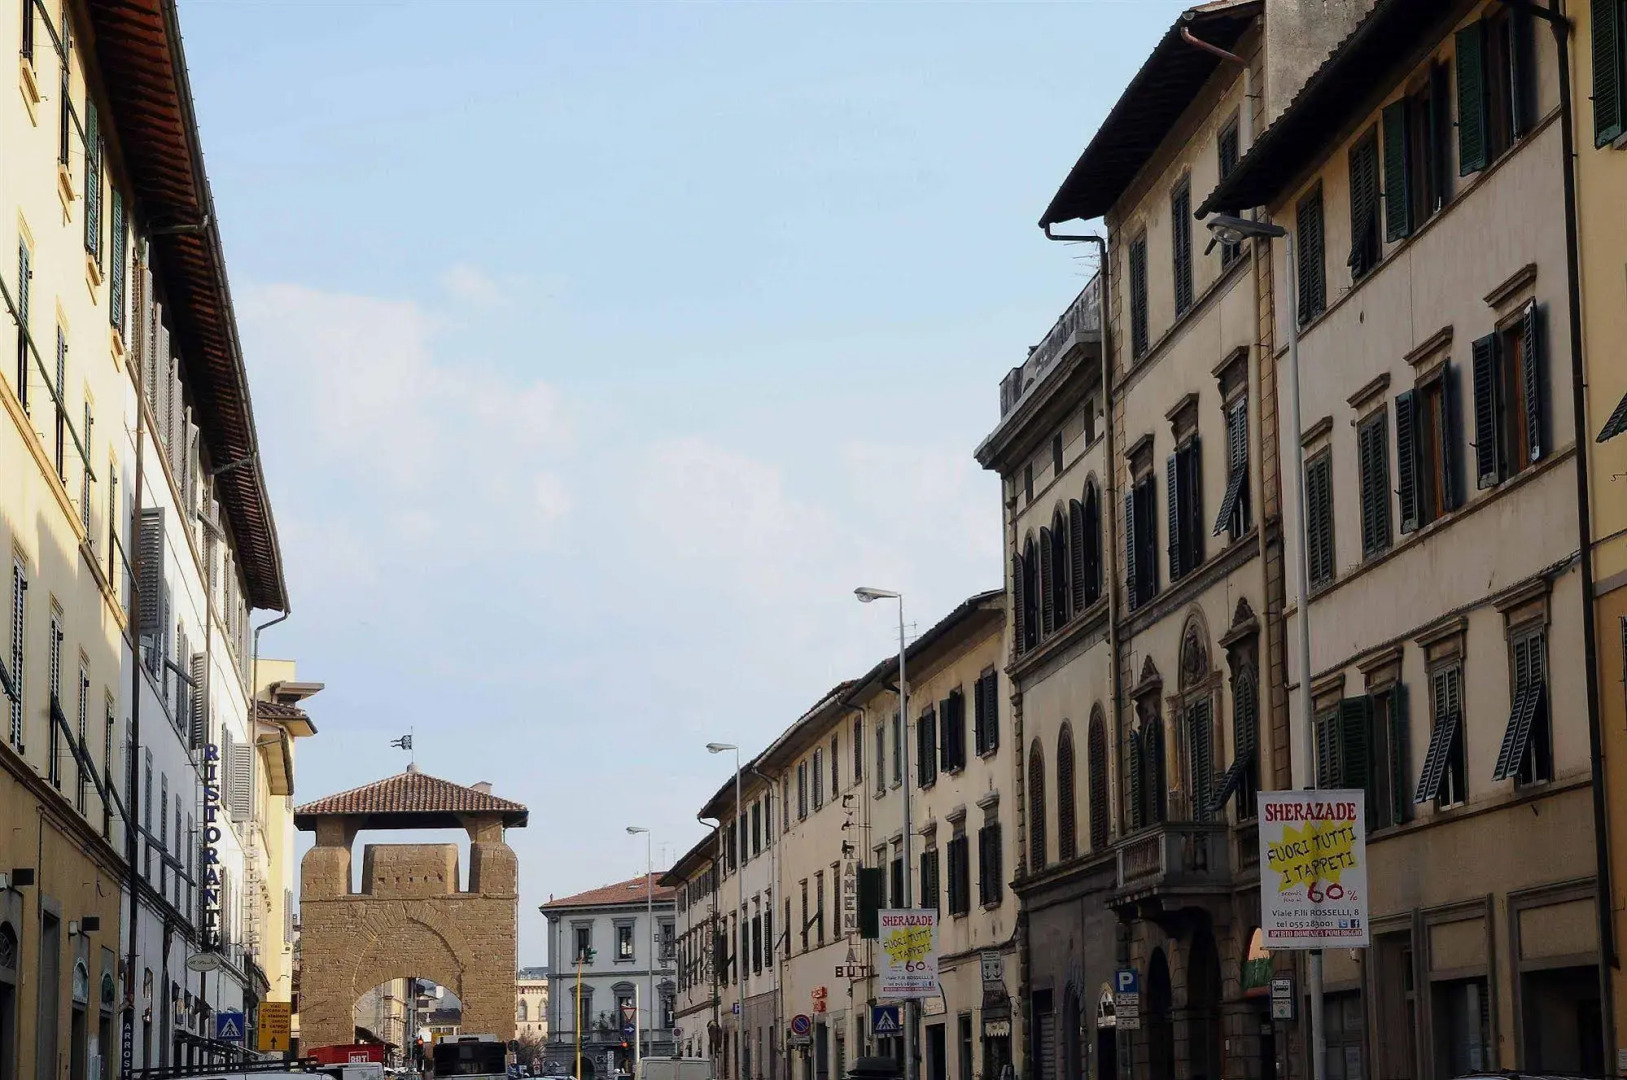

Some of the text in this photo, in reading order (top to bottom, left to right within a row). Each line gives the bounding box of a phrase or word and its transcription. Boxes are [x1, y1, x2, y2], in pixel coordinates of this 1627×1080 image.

[1265, 803, 1356, 821] SHERAZADE
[203, 744, 221, 949] RISTORANT
[1267, 827, 1356, 863] FUORI TUTTI
[1283, 852, 1354, 884] I TAPPETI
[1307, 881, 1344, 903] 60
[882, 916, 933, 926] SHERAZADE
[1272, 909, 1292, 917] Viale
[1311, 909, 1352, 918] ROSSELLI,
[1354, 908, 1359, 916] 8
[1276, 920, 1288, 928] tel
[1289, 921, 1304, 929] 055
[884, 930, 933, 949] FUORI TUTTI
[898, 943, 931, 958] TAPPETI
[905, 960, 926, 972] 60
[1119, 972, 1133, 991] P
